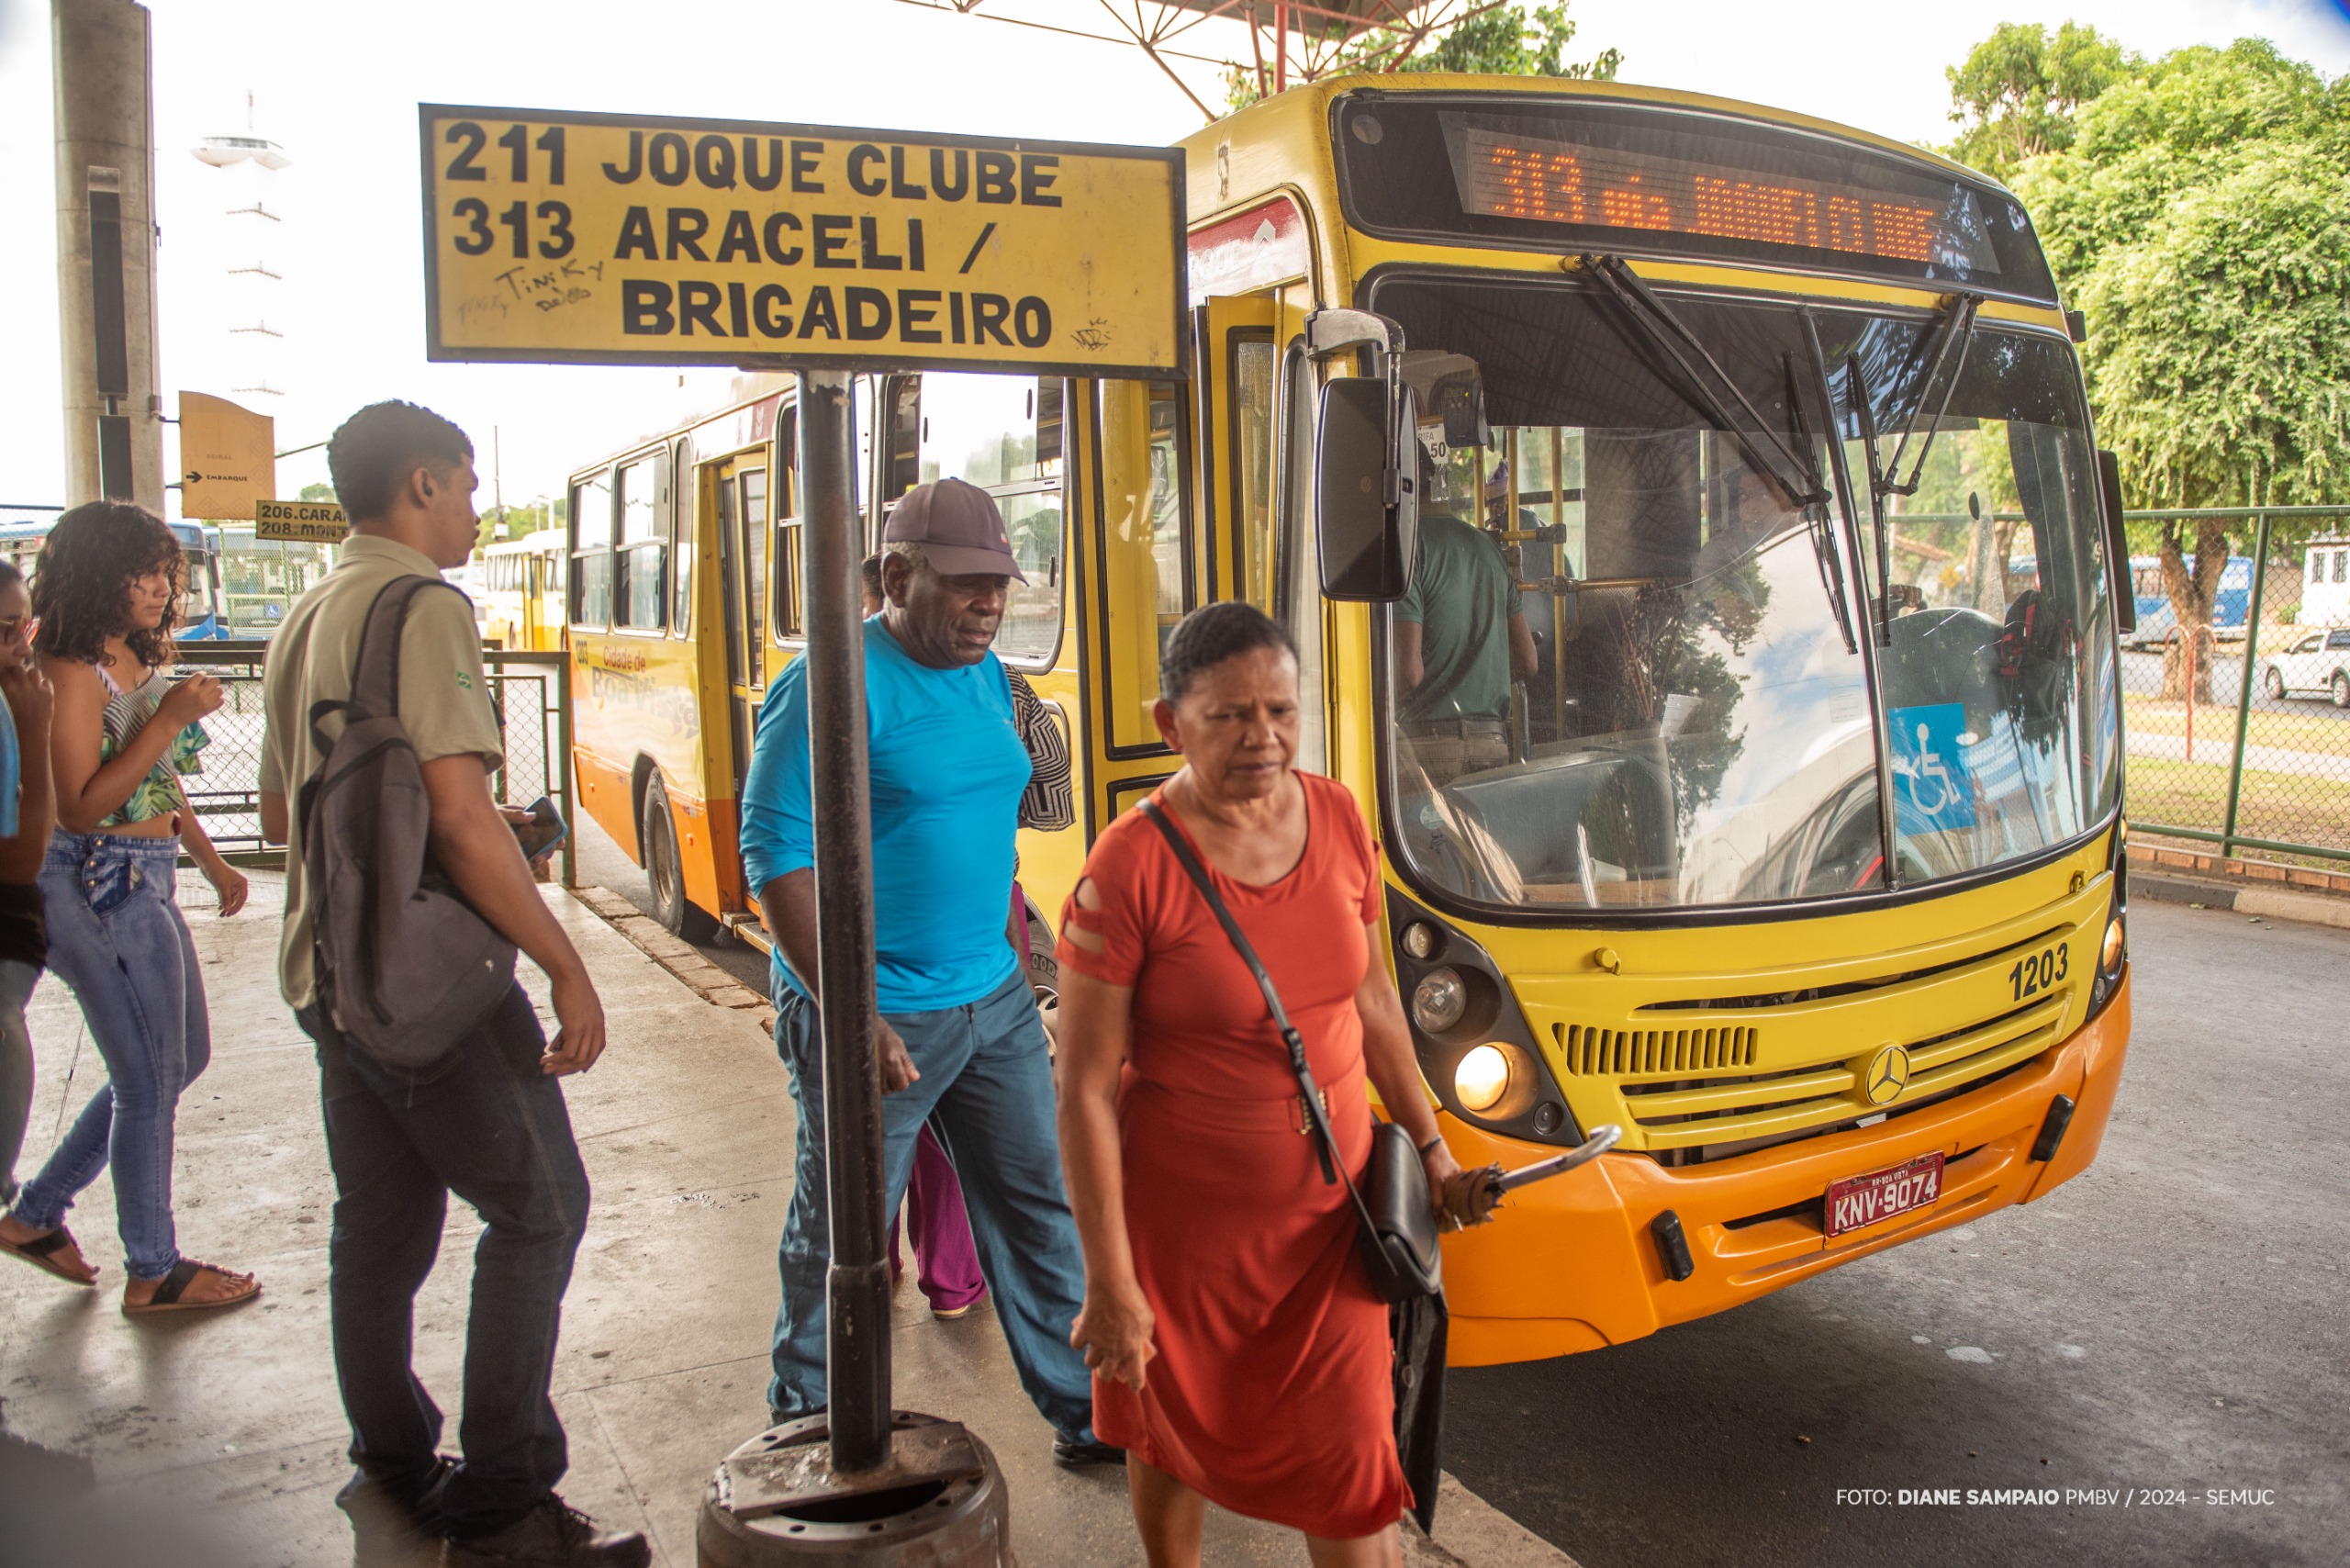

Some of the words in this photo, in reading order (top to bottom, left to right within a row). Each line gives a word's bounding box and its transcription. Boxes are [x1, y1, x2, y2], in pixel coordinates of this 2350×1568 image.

[445, 121, 566, 187] 211
[600, 130, 827, 204] JOQUE
[845, 143, 1064, 209] CLUBE
[1491, 148, 1584, 221] 313
[452, 196, 576, 261] 313
[612, 204, 926, 273] ARACELI
[957, 221, 998, 275] /
[621, 278, 1053, 349] BRIGADEIRO
[206, 474, 249, 483] EMBARQUE
[591, 666, 630, 705] Boa
[602, 644, 632, 670] Cidade
[633, 649, 646, 673] de
[2009, 942, 2068, 1002] 1203
